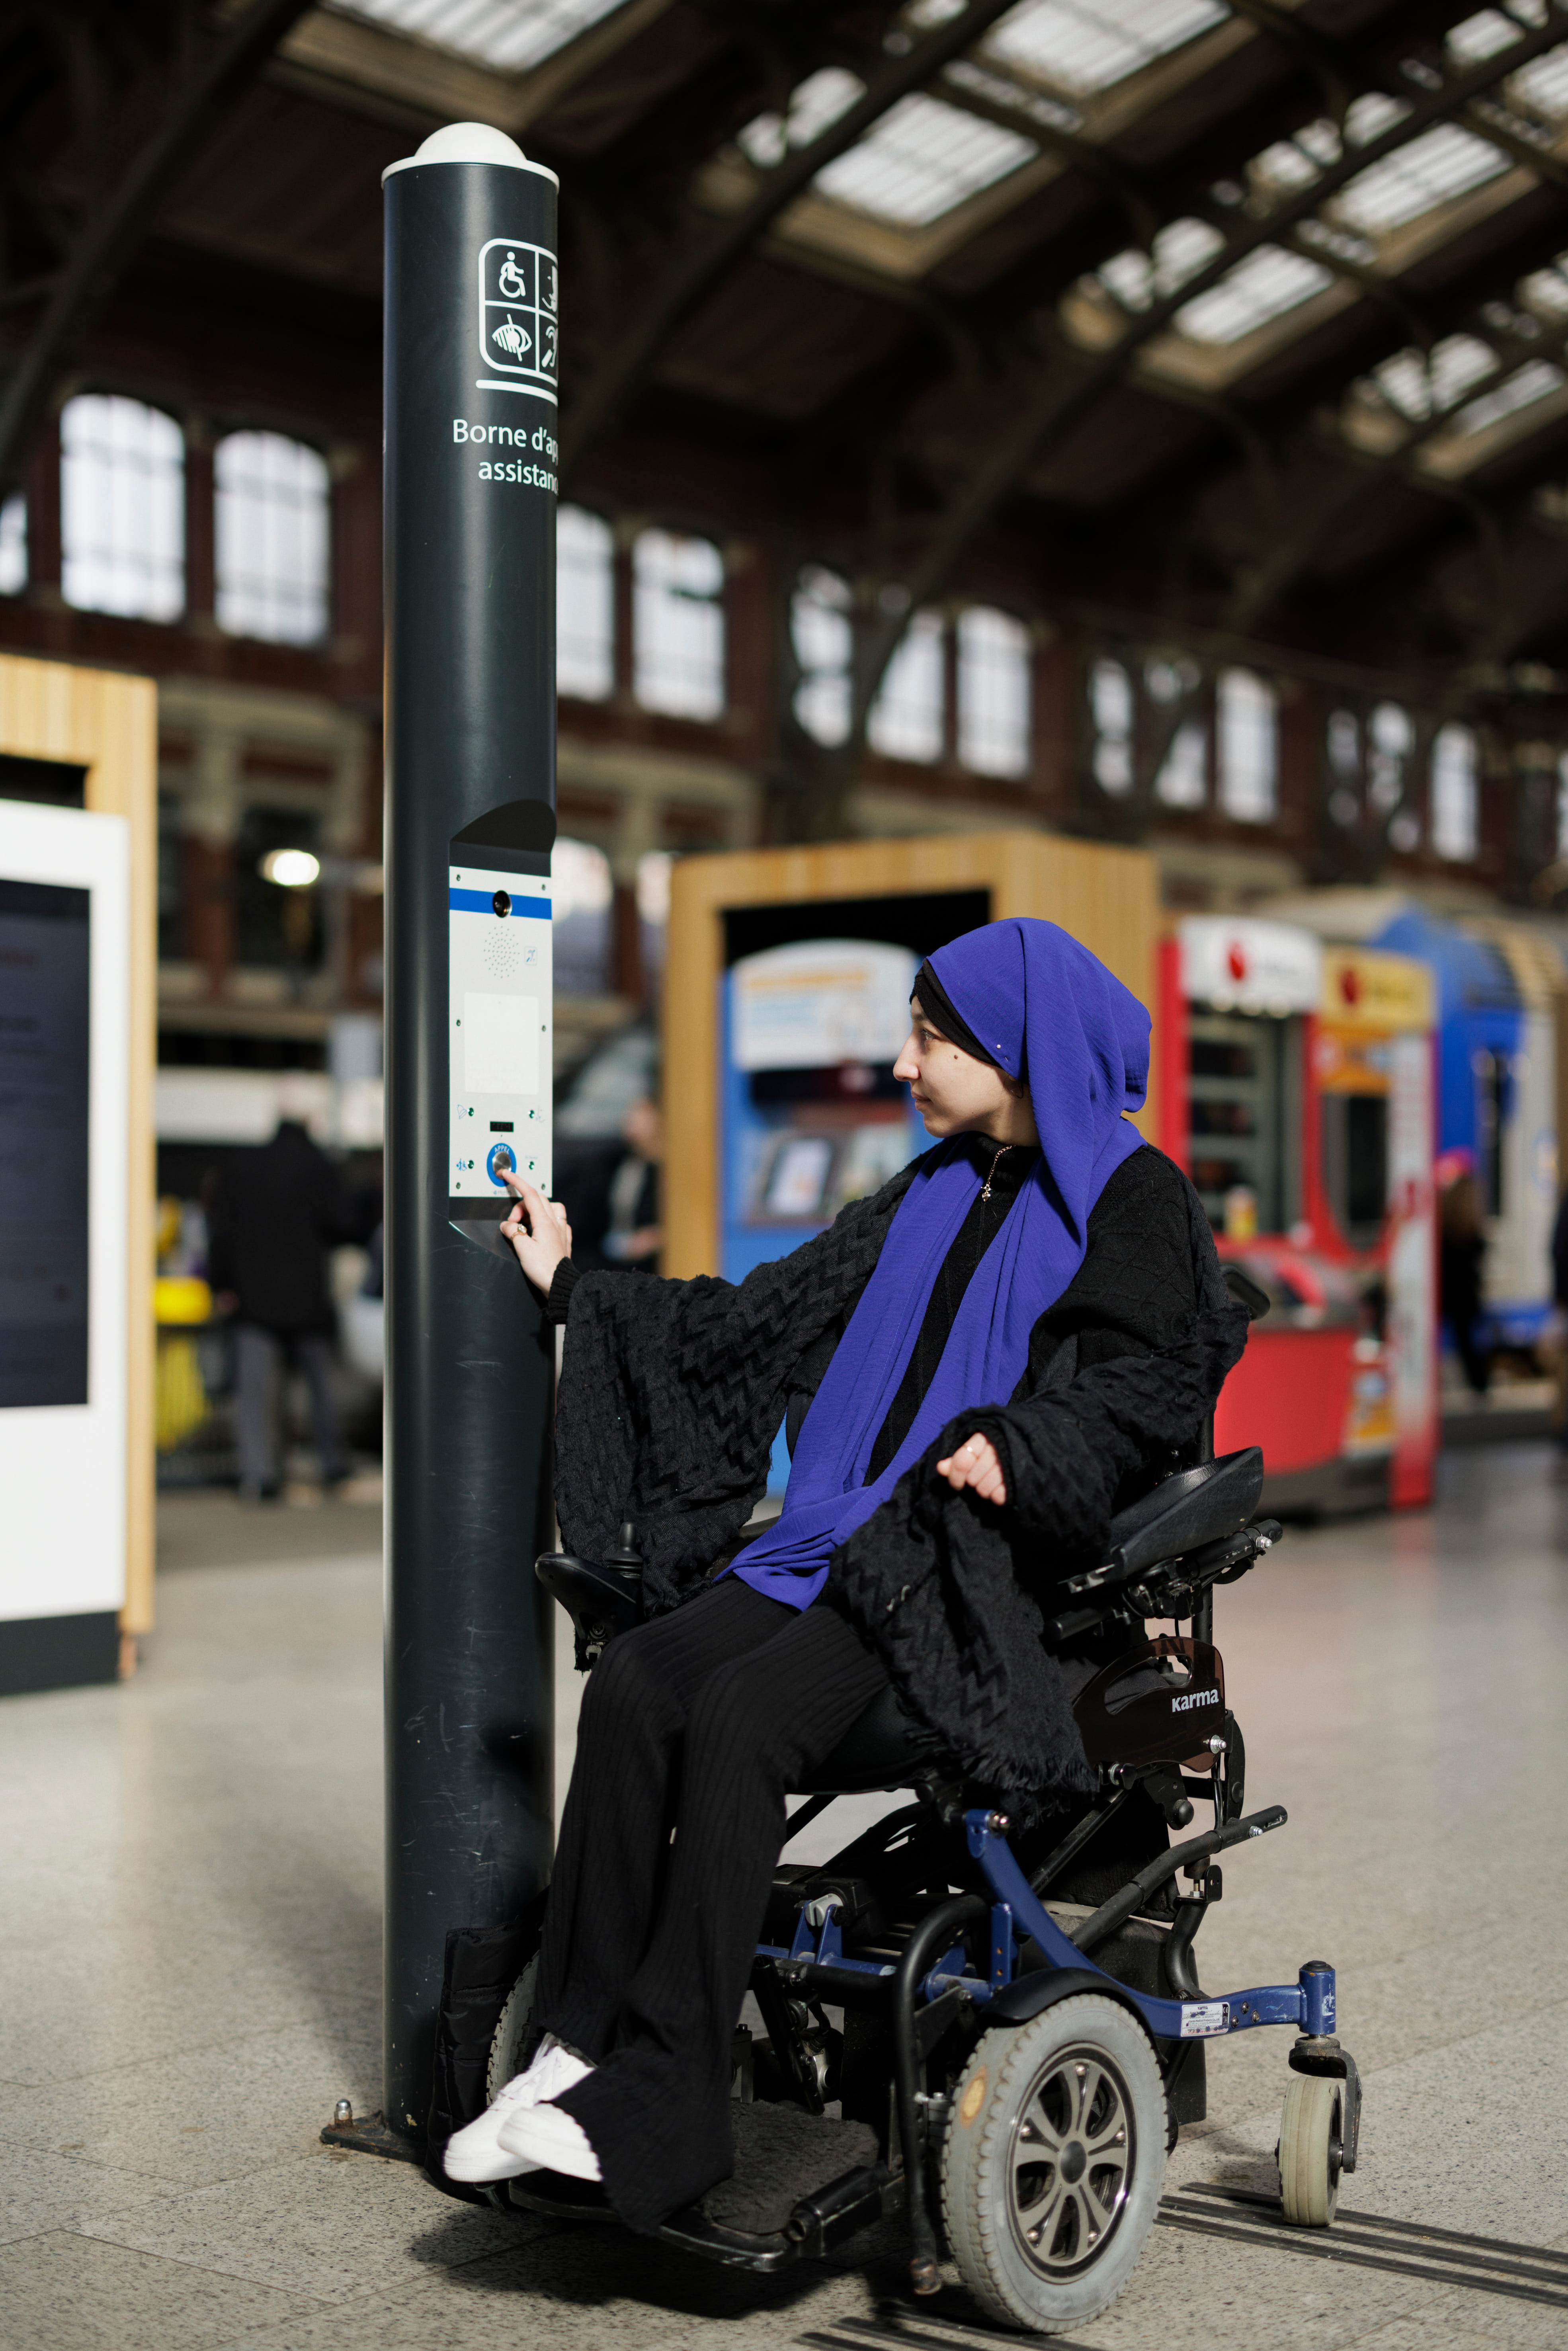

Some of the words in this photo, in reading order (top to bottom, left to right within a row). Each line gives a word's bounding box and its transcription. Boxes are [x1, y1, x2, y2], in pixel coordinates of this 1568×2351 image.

[453, 419, 527, 447] Borne
[478, 459, 558, 496] assistanc
[495, 1145, 510, 1154] APPEL
